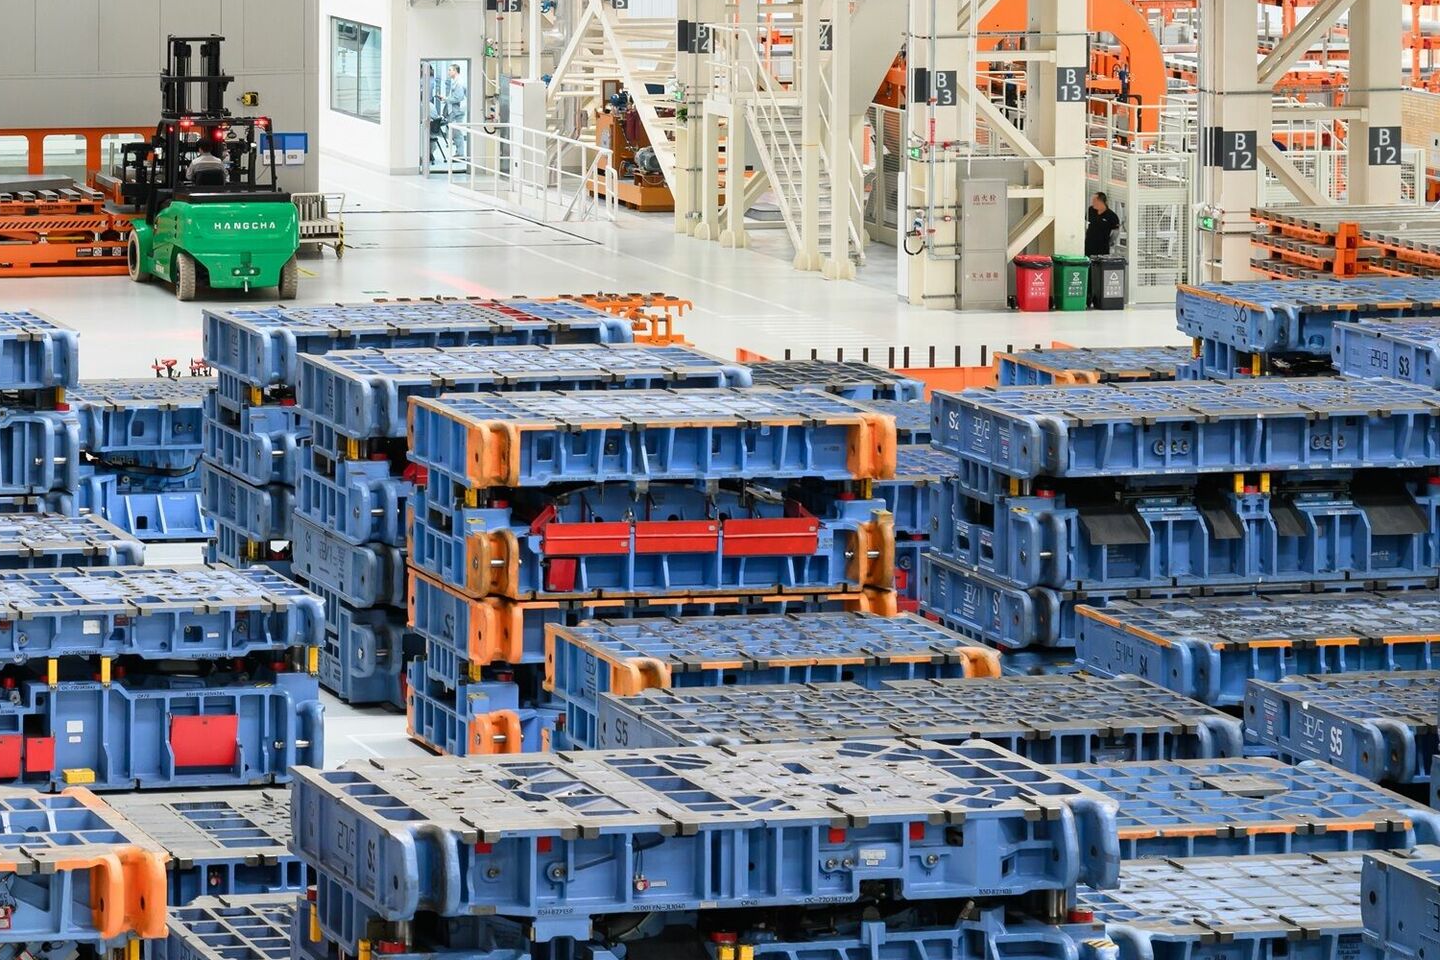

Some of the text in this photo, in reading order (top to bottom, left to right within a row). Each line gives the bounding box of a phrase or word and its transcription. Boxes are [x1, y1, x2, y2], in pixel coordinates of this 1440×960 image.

[936, 72, 948, 88] B
[1066, 68, 1077, 85] B
[1060, 85, 1082, 101] 13
[1234, 132, 1246, 151] B
[1378, 128, 1391, 146] B
[1228, 151, 1252, 169] 12
[1373, 146, 1397, 164] 12
[214, 221, 276, 230] HANGCHA
[1233, 301, 1247, 323] S6
[1399, 355, 1410, 377] S3
[615, 717, 629, 747] S5
[1329, 726, 1343, 756] S5
